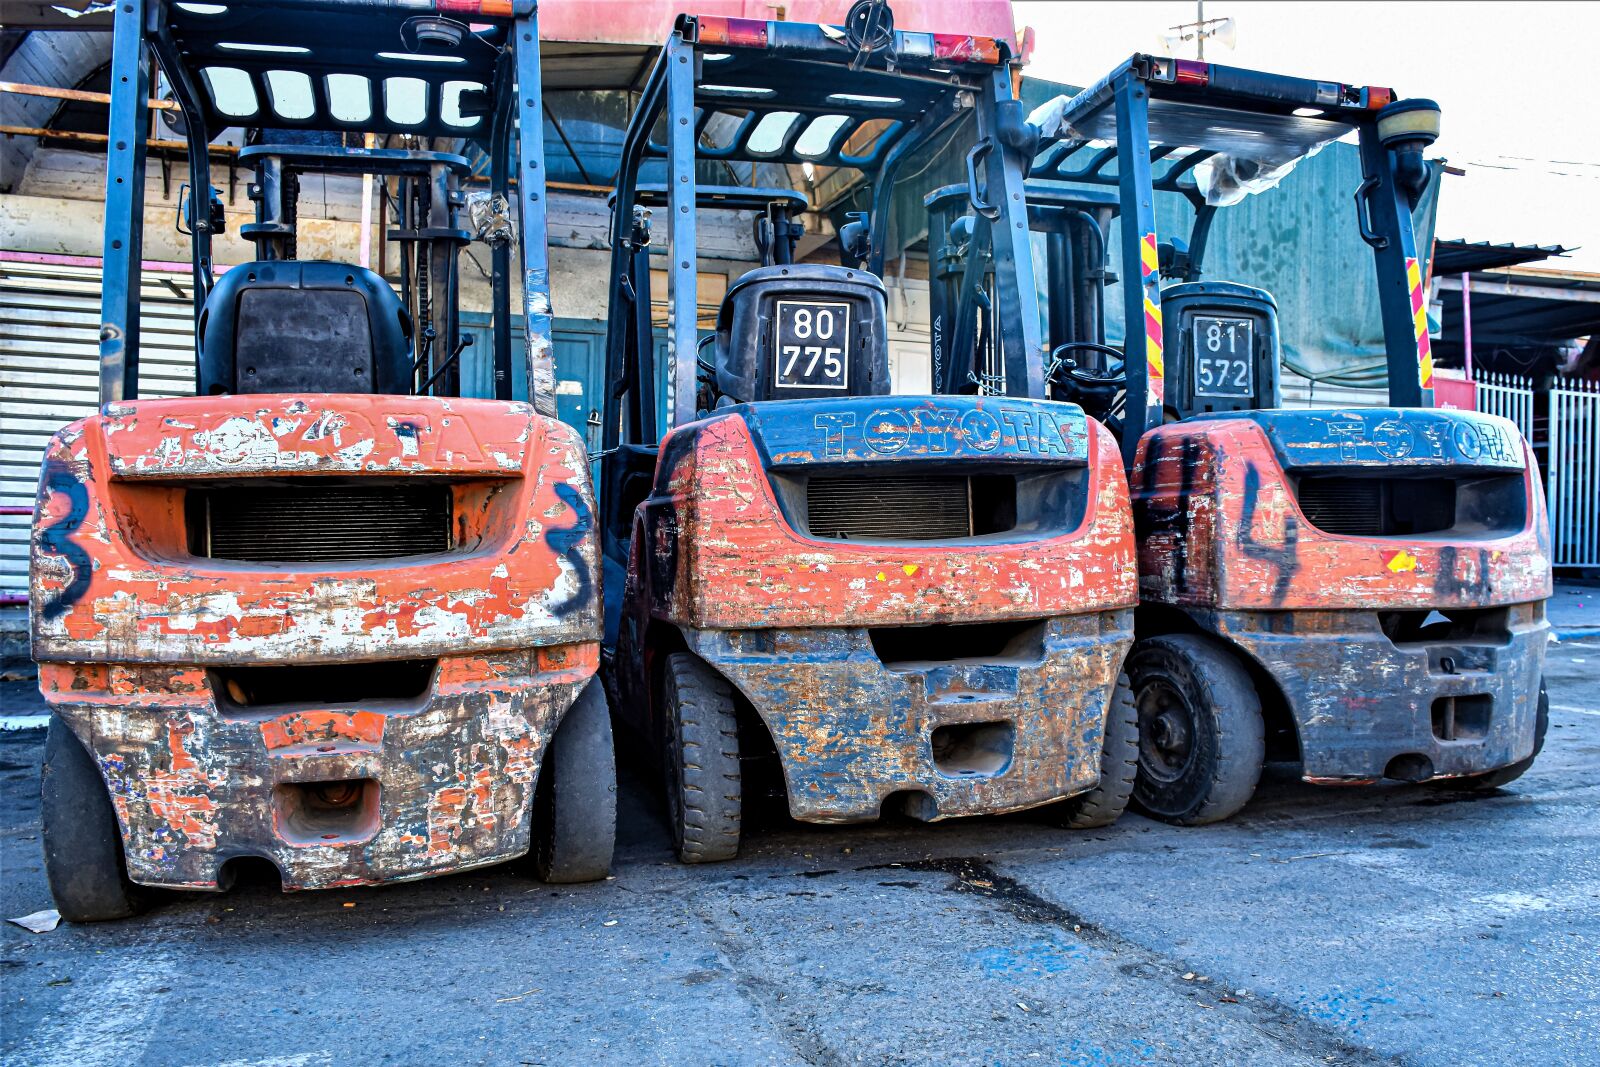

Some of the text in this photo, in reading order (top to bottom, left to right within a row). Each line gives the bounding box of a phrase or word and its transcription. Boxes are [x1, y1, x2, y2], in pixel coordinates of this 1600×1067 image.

[794, 308, 834, 340] 80
[1206, 324, 1235, 353] 81
[782, 345, 842, 378] 775
[1199, 358, 1248, 387] 572
[815, 407, 1070, 457] TOYOTA
[1327, 419, 1518, 464] TOYOTA
[41, 471, 93, 621] 3
[544, 481, 593, 617] 3
[1238, 459, 1302, 607] 4
